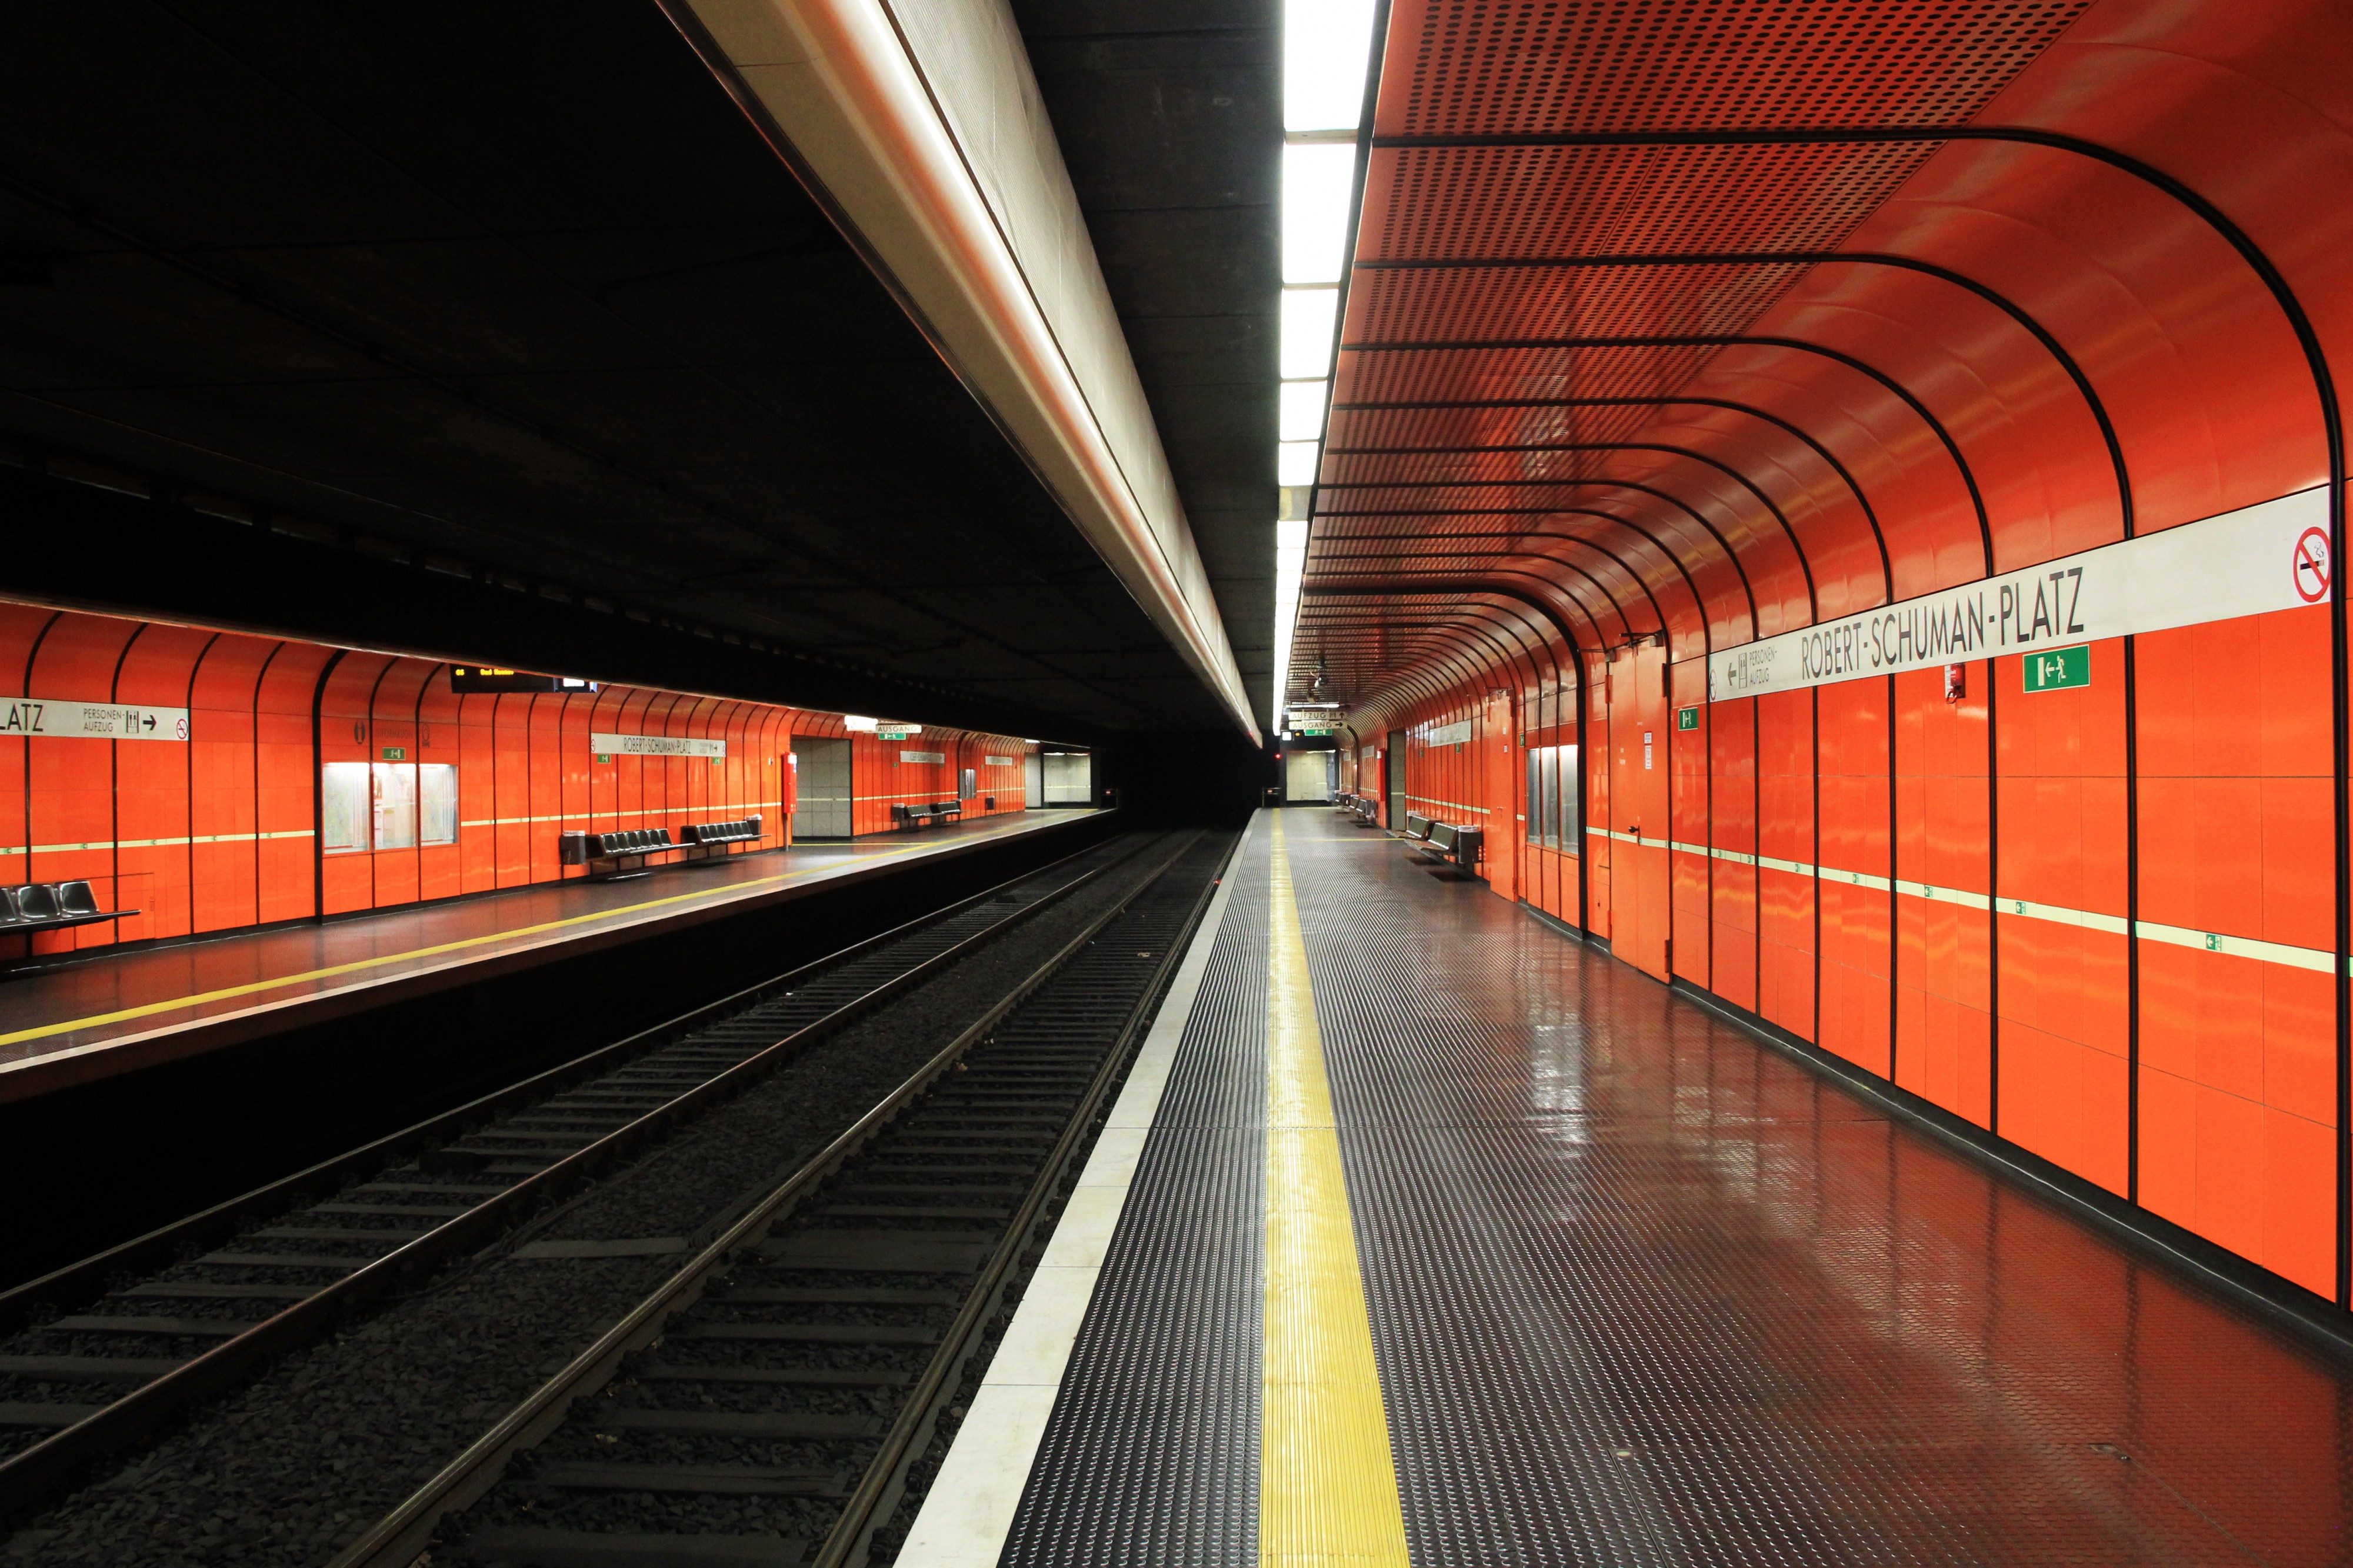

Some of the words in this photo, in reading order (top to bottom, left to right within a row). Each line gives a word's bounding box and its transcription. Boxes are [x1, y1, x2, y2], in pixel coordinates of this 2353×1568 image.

[1801, 566, 2084, 680] ROBERT-SCHUMAN-PLATZ
[1749, 646, 1777, 667] PERSONEN-
[1749, 668, 1769, 686] AUFZUG
[84, 708, 125, 719] PERSONEN-
[84, 722, 114, 732] AUFZUG
